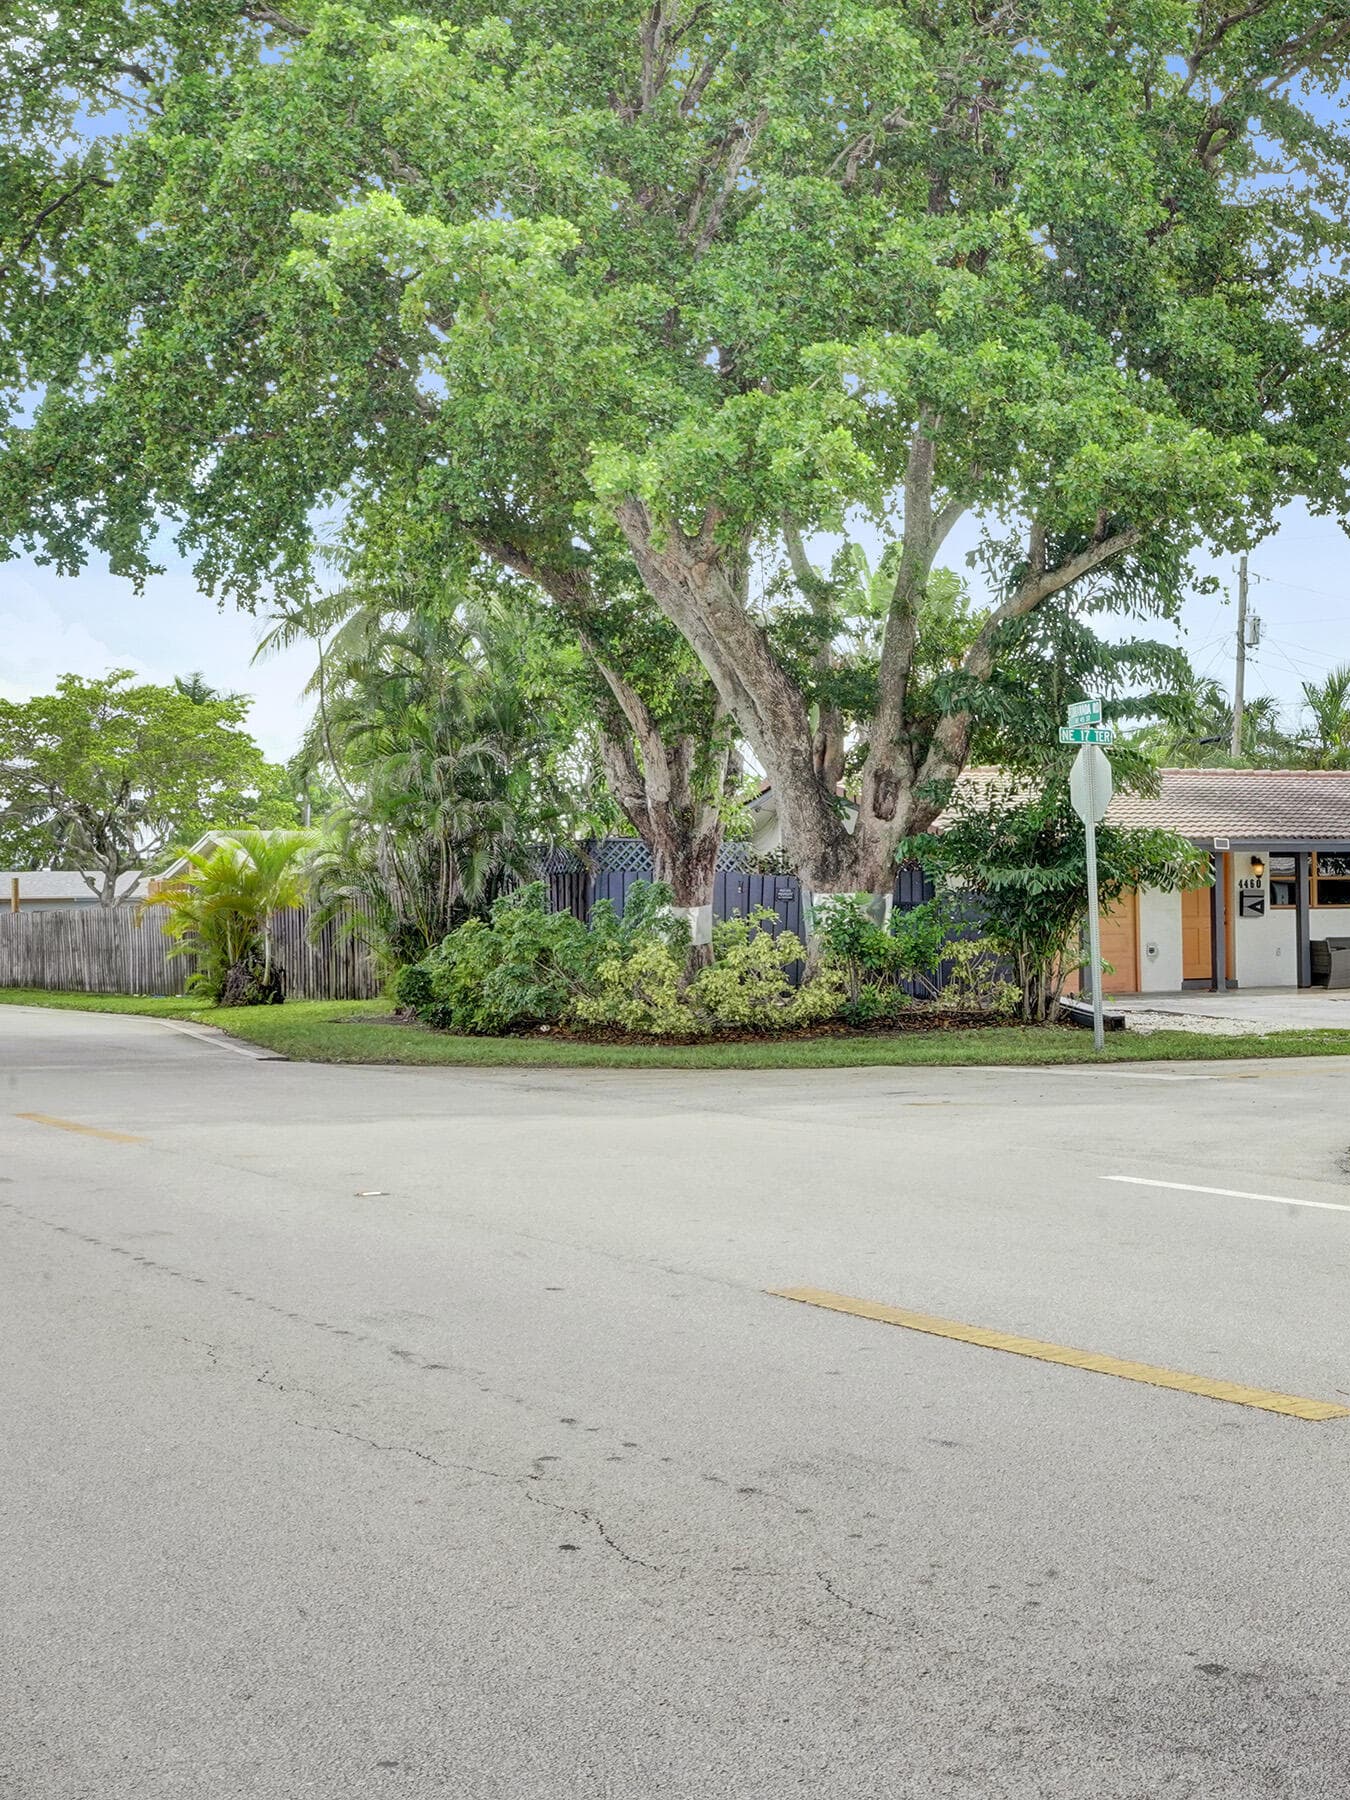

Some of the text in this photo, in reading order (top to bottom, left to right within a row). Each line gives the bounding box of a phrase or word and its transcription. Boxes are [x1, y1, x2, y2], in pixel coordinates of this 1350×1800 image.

[1062, 729, 1110, 742] NE 17 TER
